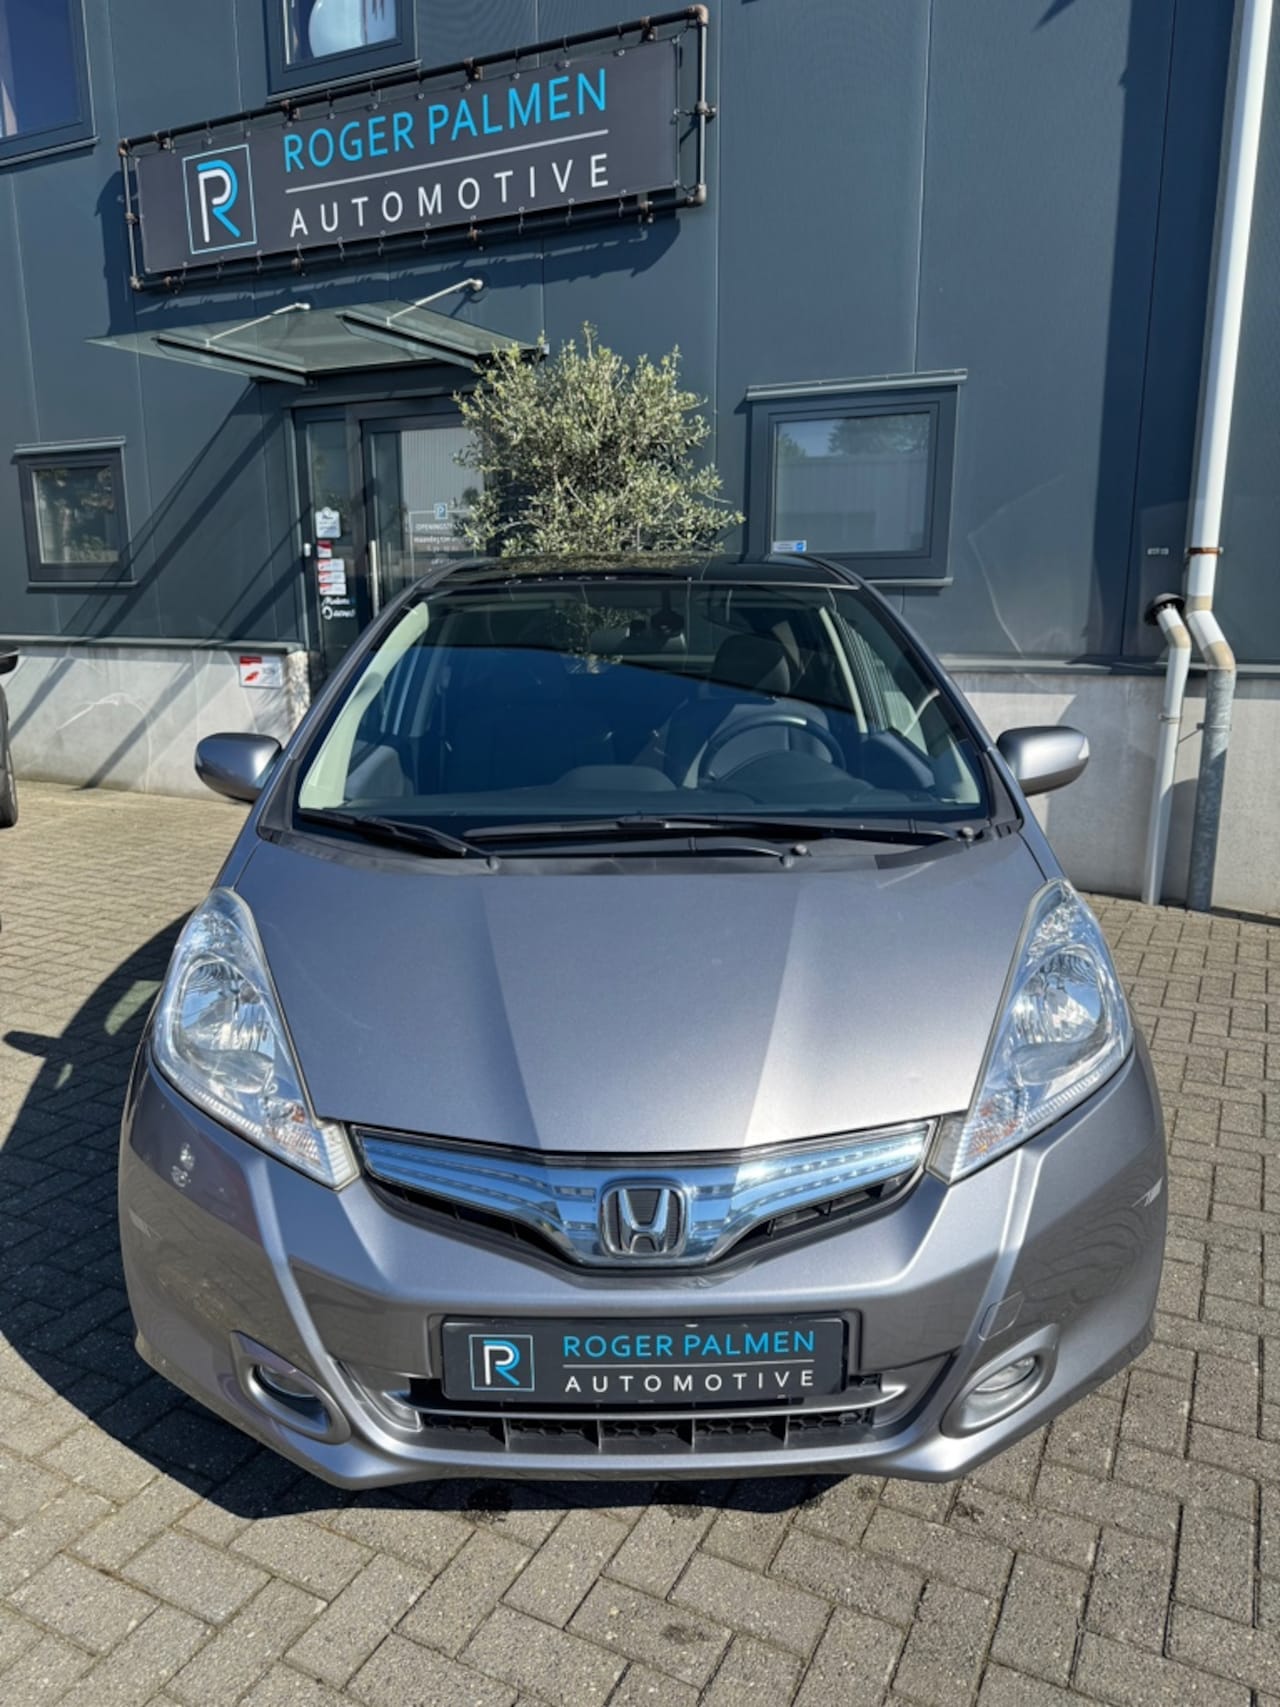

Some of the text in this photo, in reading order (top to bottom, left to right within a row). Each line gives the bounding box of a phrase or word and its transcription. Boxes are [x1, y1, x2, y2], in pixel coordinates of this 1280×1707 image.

[284, 68, 607, 172] ROGER PALMEN
[290, 153, 609, 238] AUTOMOTIVE
[563, 1331, 814, 1357] ROGER PALMEN
[565, 1370, 814, 1393] AUTOMOTIVE
